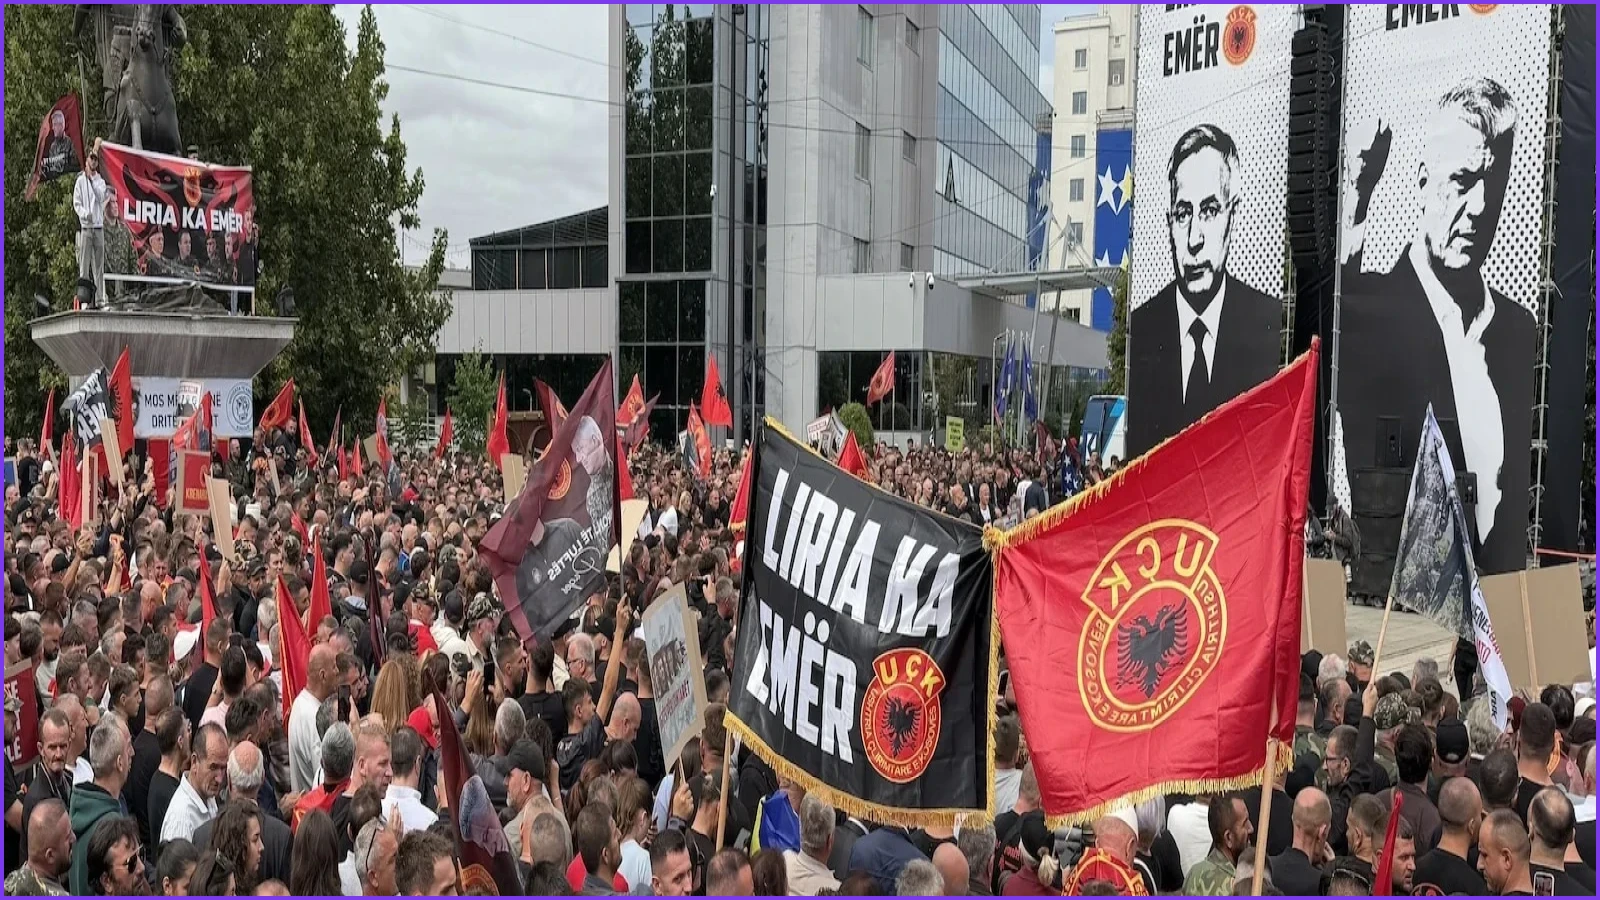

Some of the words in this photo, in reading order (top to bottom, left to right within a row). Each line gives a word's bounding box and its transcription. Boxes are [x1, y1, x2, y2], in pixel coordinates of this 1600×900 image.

[1163, 14, 1220, 77] EMËR
[123, 198, 178, 228] LIRIA
[182, 206, 208, 230] KA
[210, 208, 244, 233] EMËR
[144, 393, 165, 407] MOS
[763, 467, 881, 624] LIRIA
[878, 534, 961, 639] KA
[746, 599, 858, 765] EMËR
[879, 654, 941, 699] UÇK
